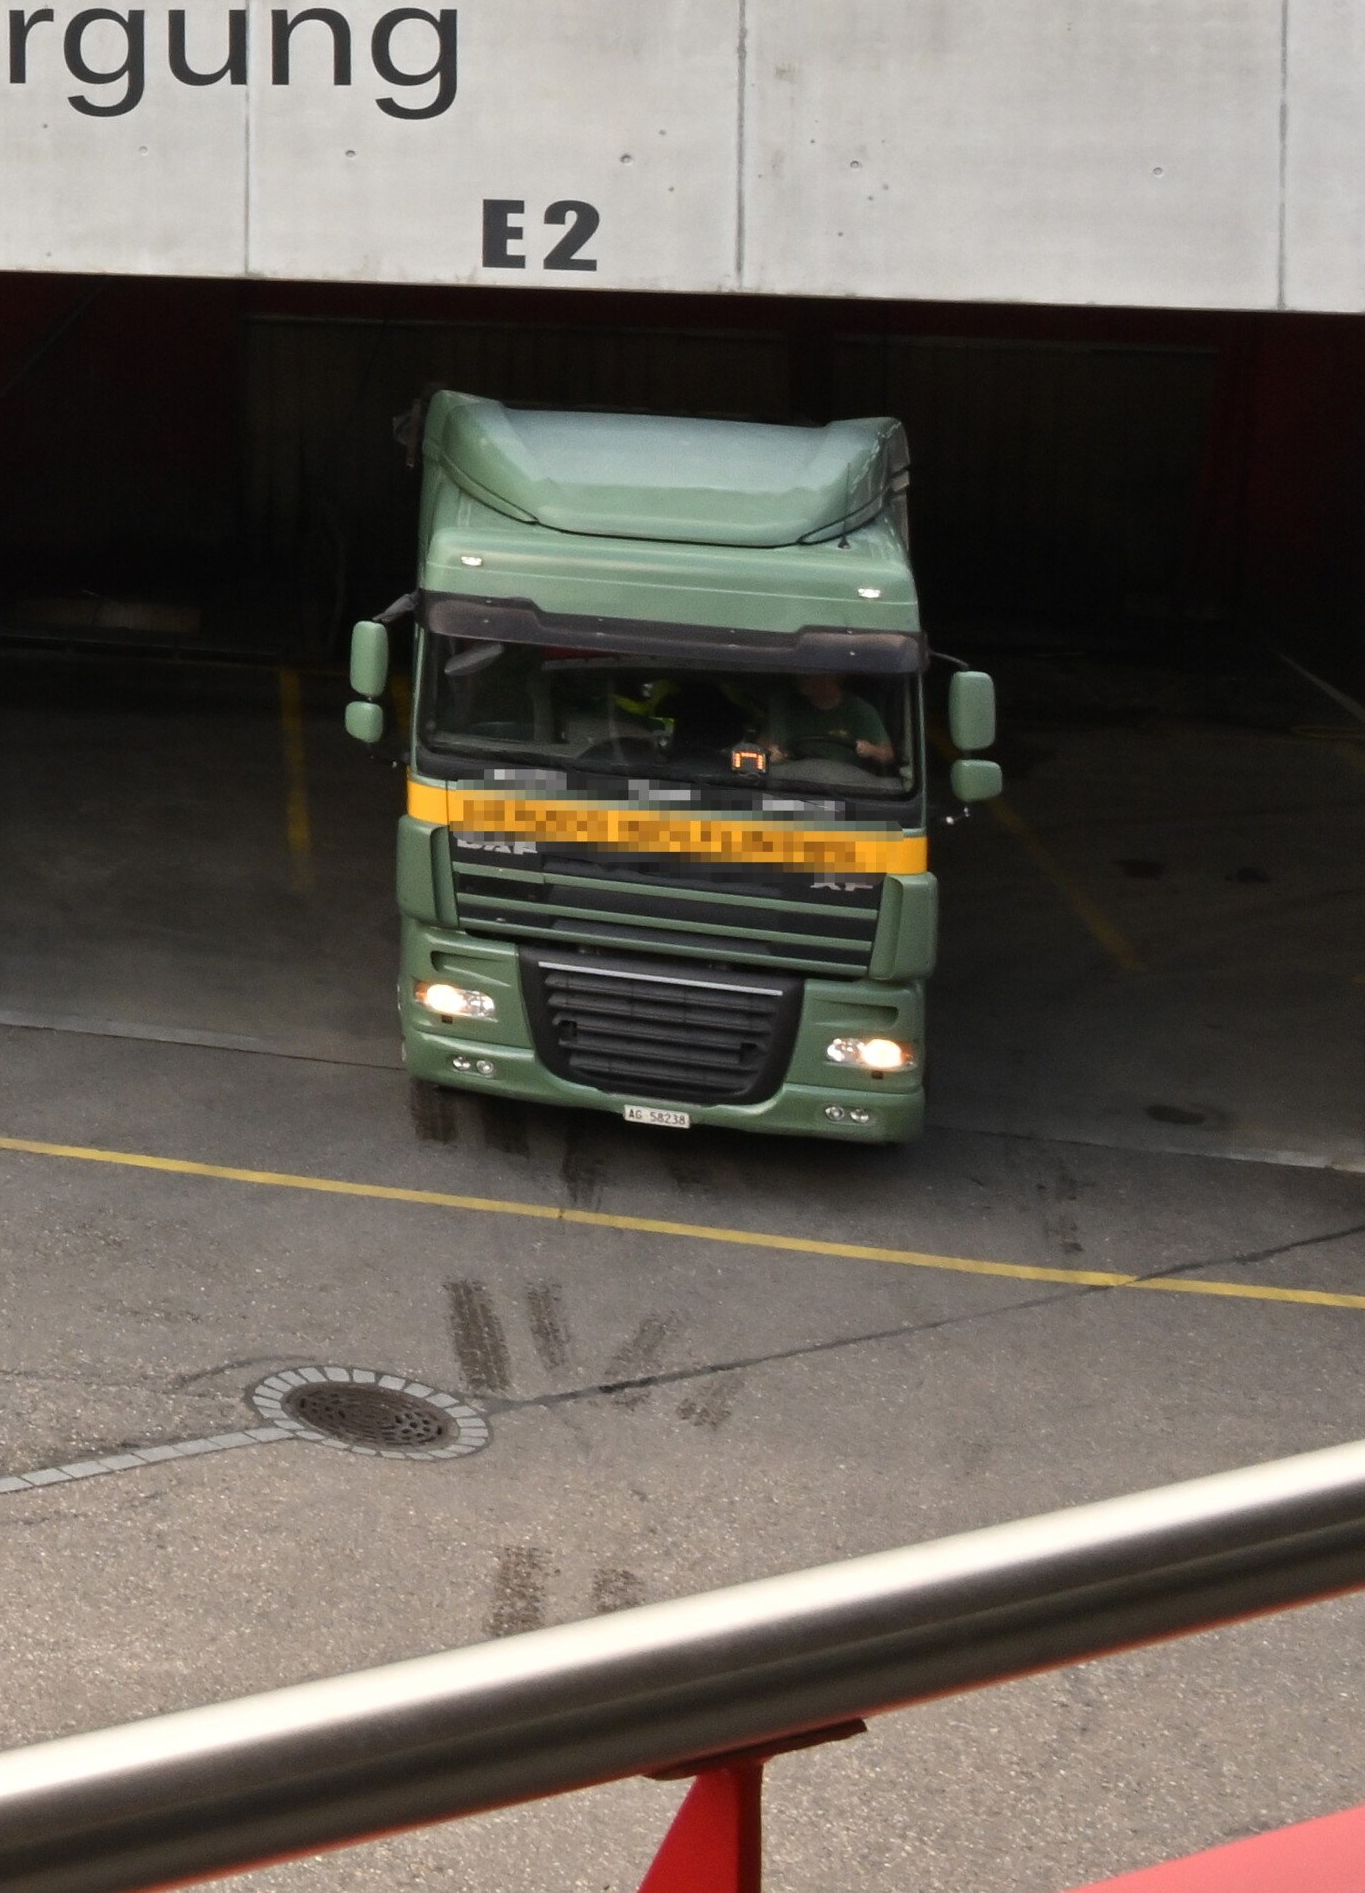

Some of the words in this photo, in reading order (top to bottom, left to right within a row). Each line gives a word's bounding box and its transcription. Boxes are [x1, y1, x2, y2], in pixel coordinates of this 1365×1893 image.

[482, 199, 600, 271] E2
[629, 1108, 643, 1119] AG
[650, 1111, 686, 1125] 58238
